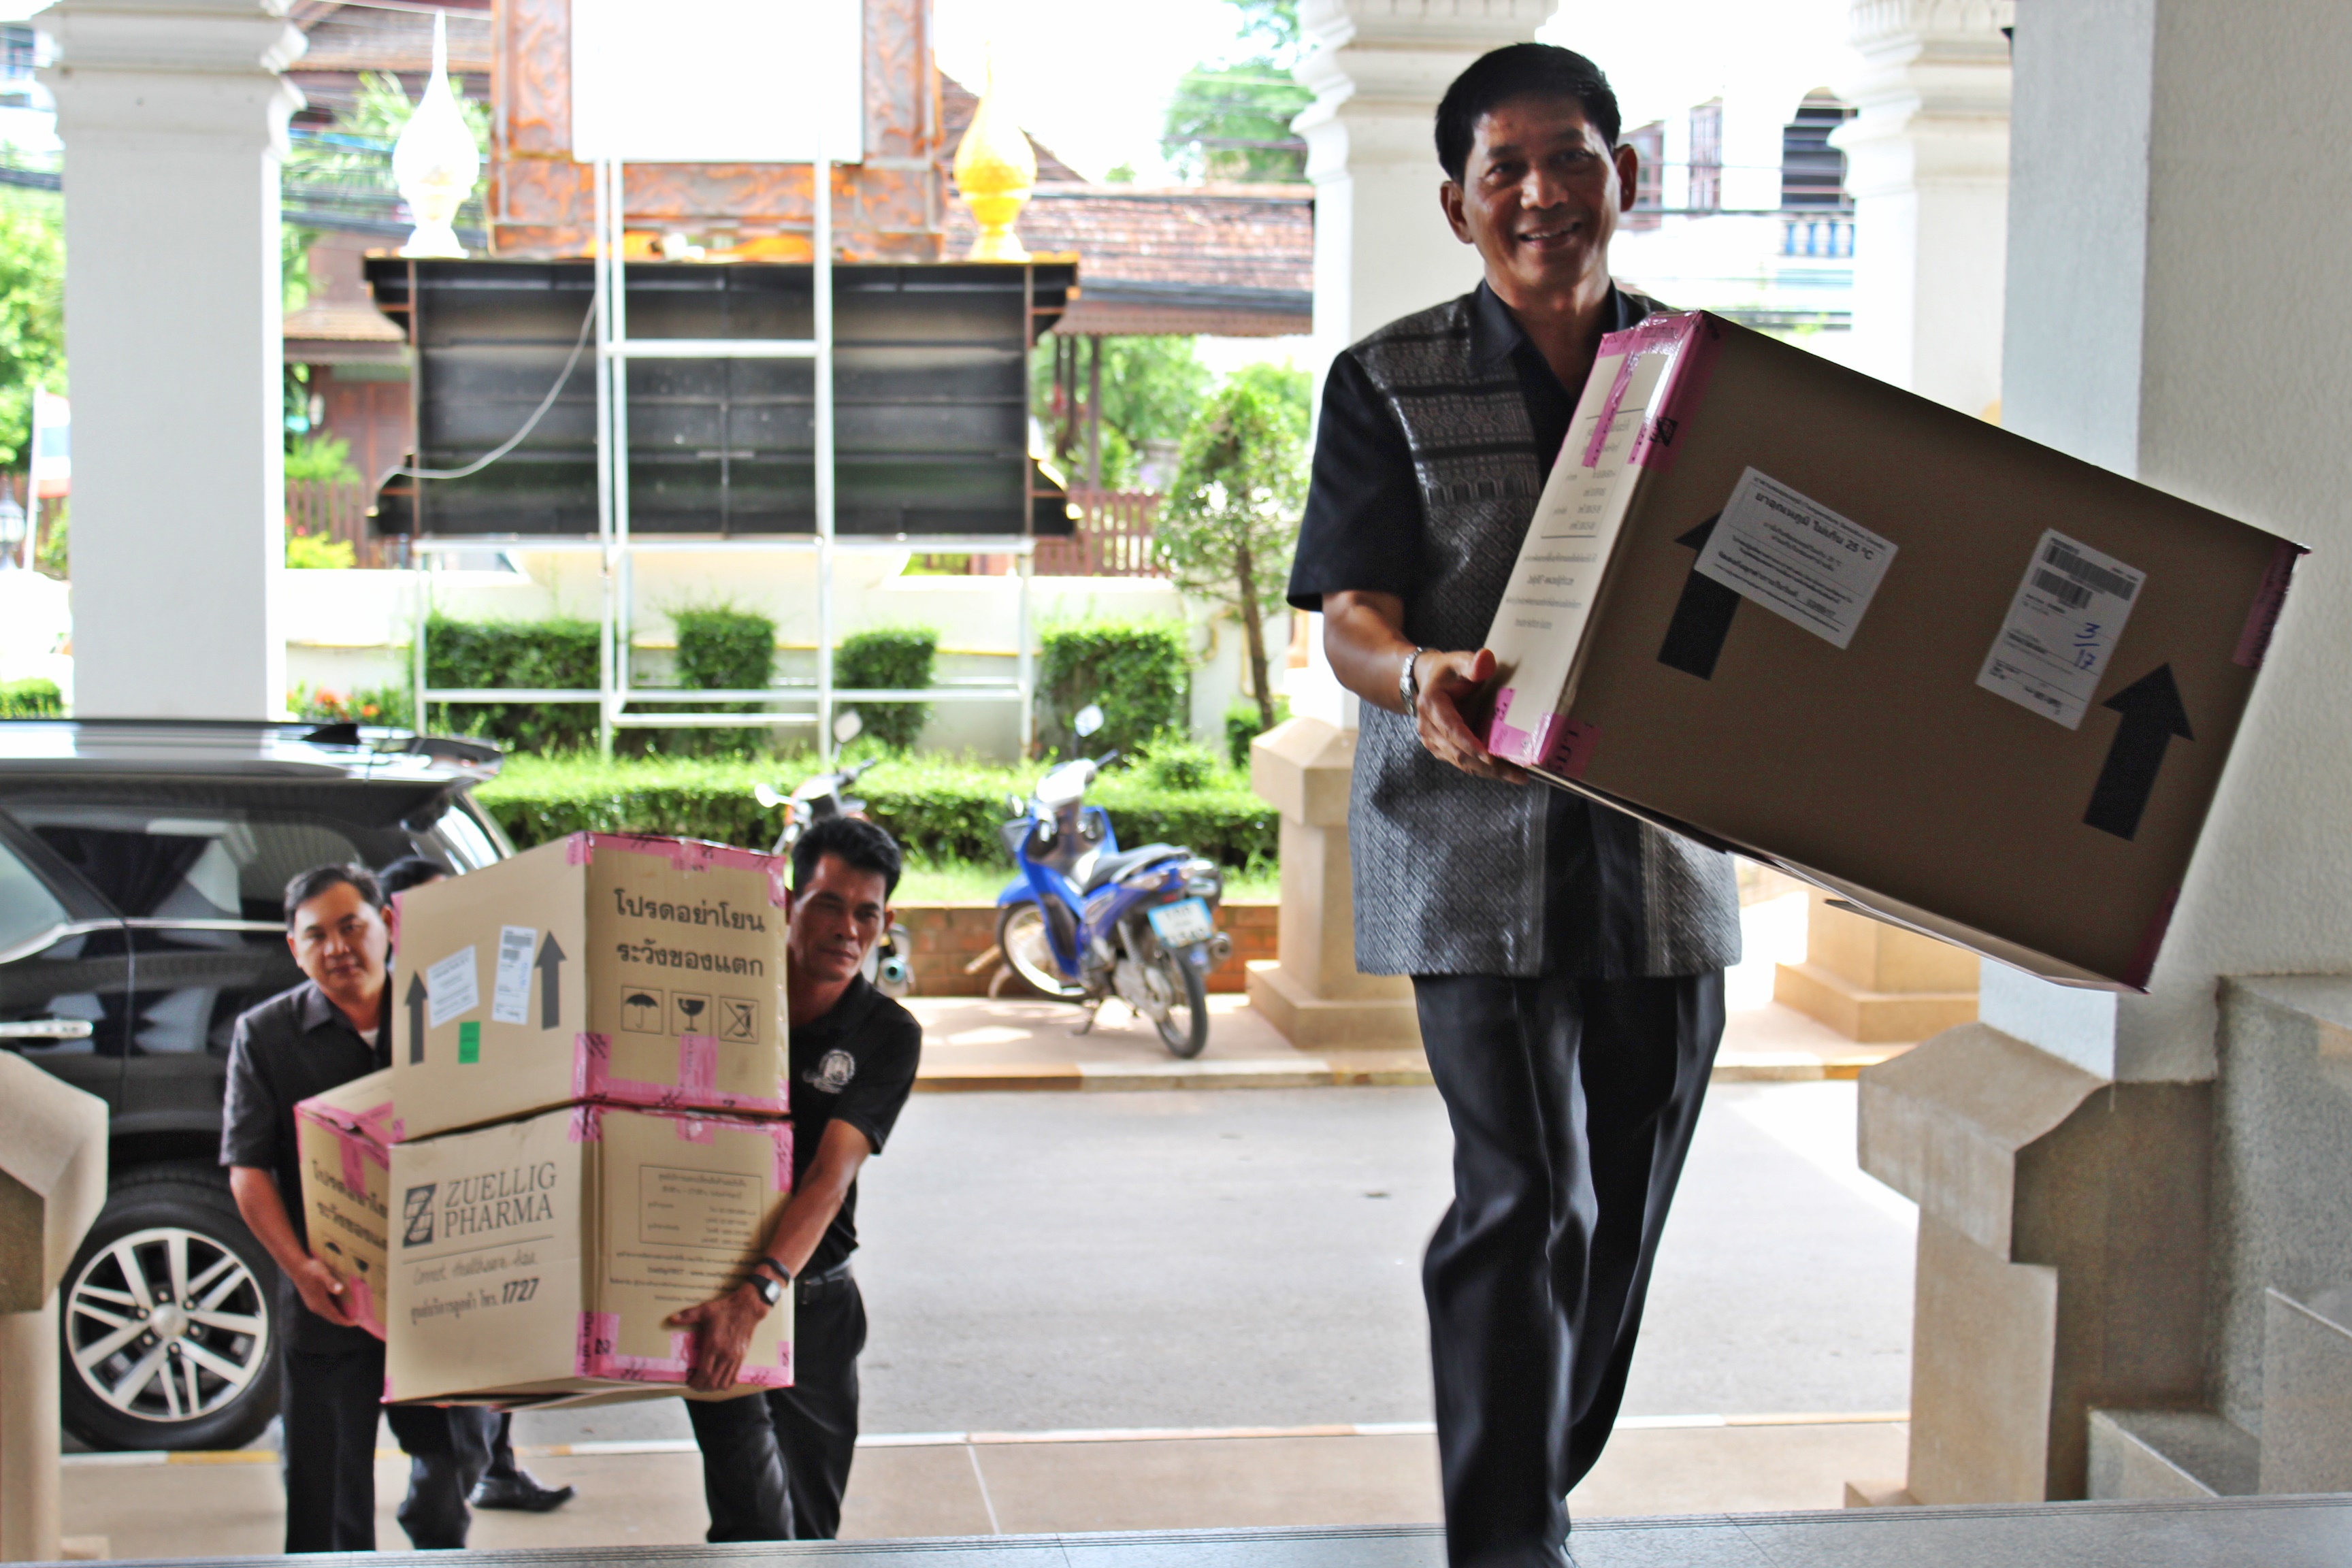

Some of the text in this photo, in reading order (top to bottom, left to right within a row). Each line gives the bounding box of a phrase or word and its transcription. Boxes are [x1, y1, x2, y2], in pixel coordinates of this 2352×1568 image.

[1845, 540, 1861, 553] 25
[614, 888, 766, 933] โปรดอย่าโยน
[617, 938, 764, 977] ระวังของแตก
[445, 1161, 557, 1208] ZUELLIG
[444, 1193, 555, 1239] PHARMA
[502, 1277, 540, 1305] 1727
